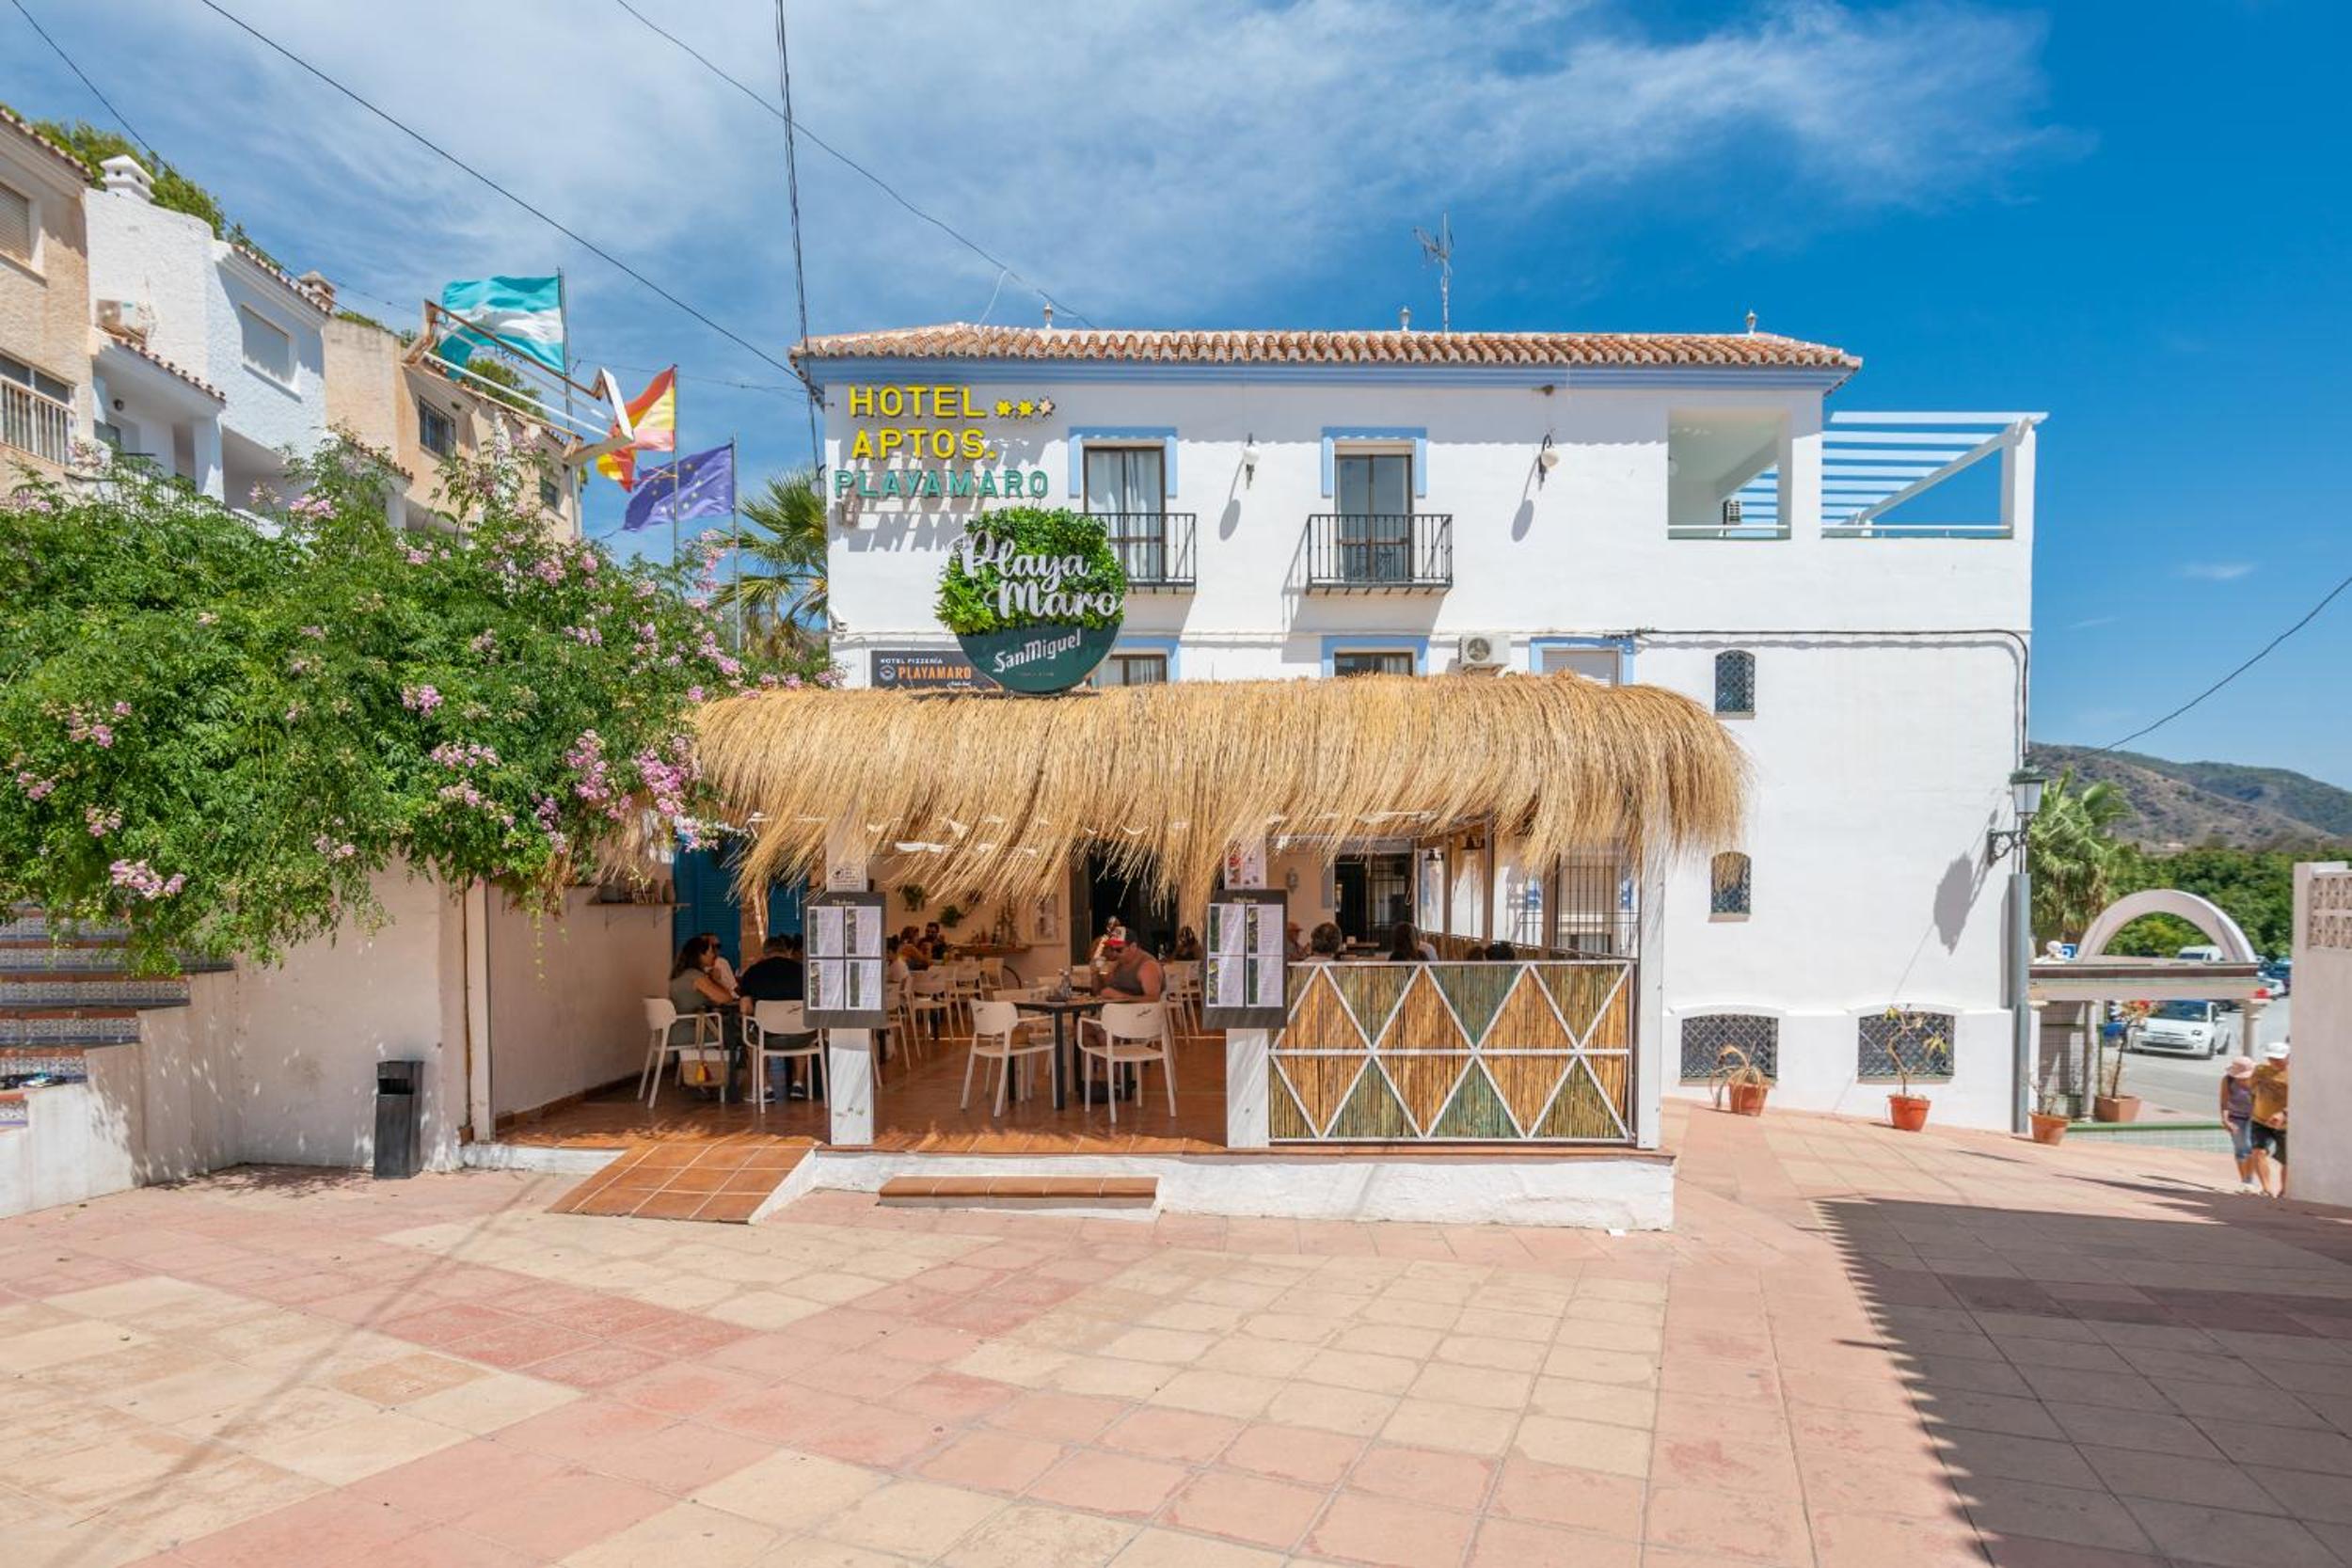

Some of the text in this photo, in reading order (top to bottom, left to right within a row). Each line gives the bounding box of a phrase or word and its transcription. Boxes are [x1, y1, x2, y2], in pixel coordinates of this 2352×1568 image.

[849, 384, 988, 418] HOTEL
[834, 469, 1049, 499] PLAYAMARO
[946, 530, 1090, 594] Playa
[983, 578, 1124, 619] Maro
[898, 666, 972, 680] PLAYAMARO
